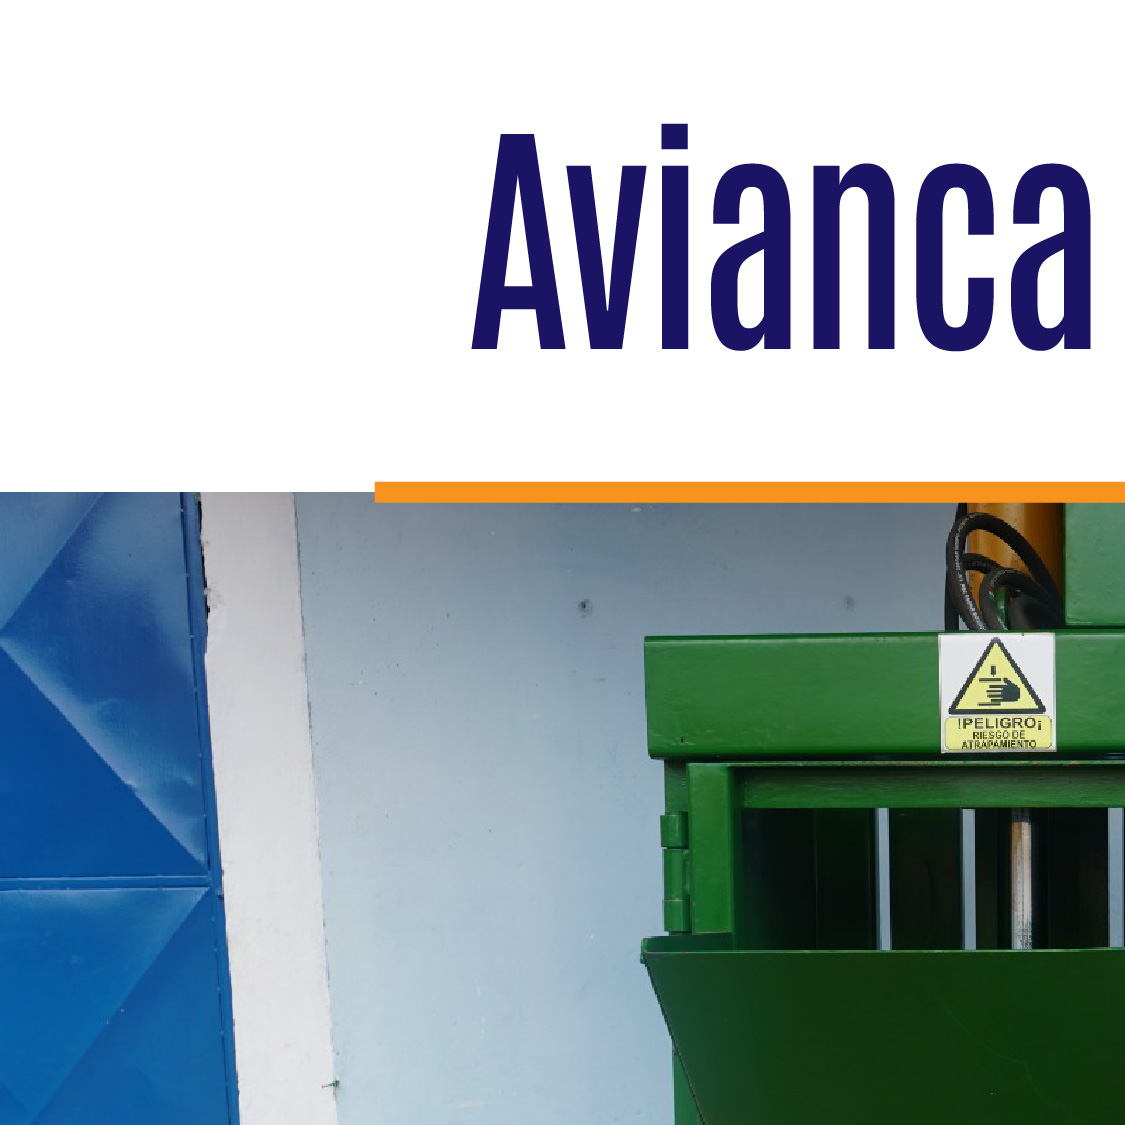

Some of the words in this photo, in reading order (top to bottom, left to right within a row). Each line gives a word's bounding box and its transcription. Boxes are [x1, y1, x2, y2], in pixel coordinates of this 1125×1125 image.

[972, 730, 1010, 740] RIESGO
[1011, 730, 1026, 740] DE
[961, 739, 1037, 750] ATRAPAMIENTO
